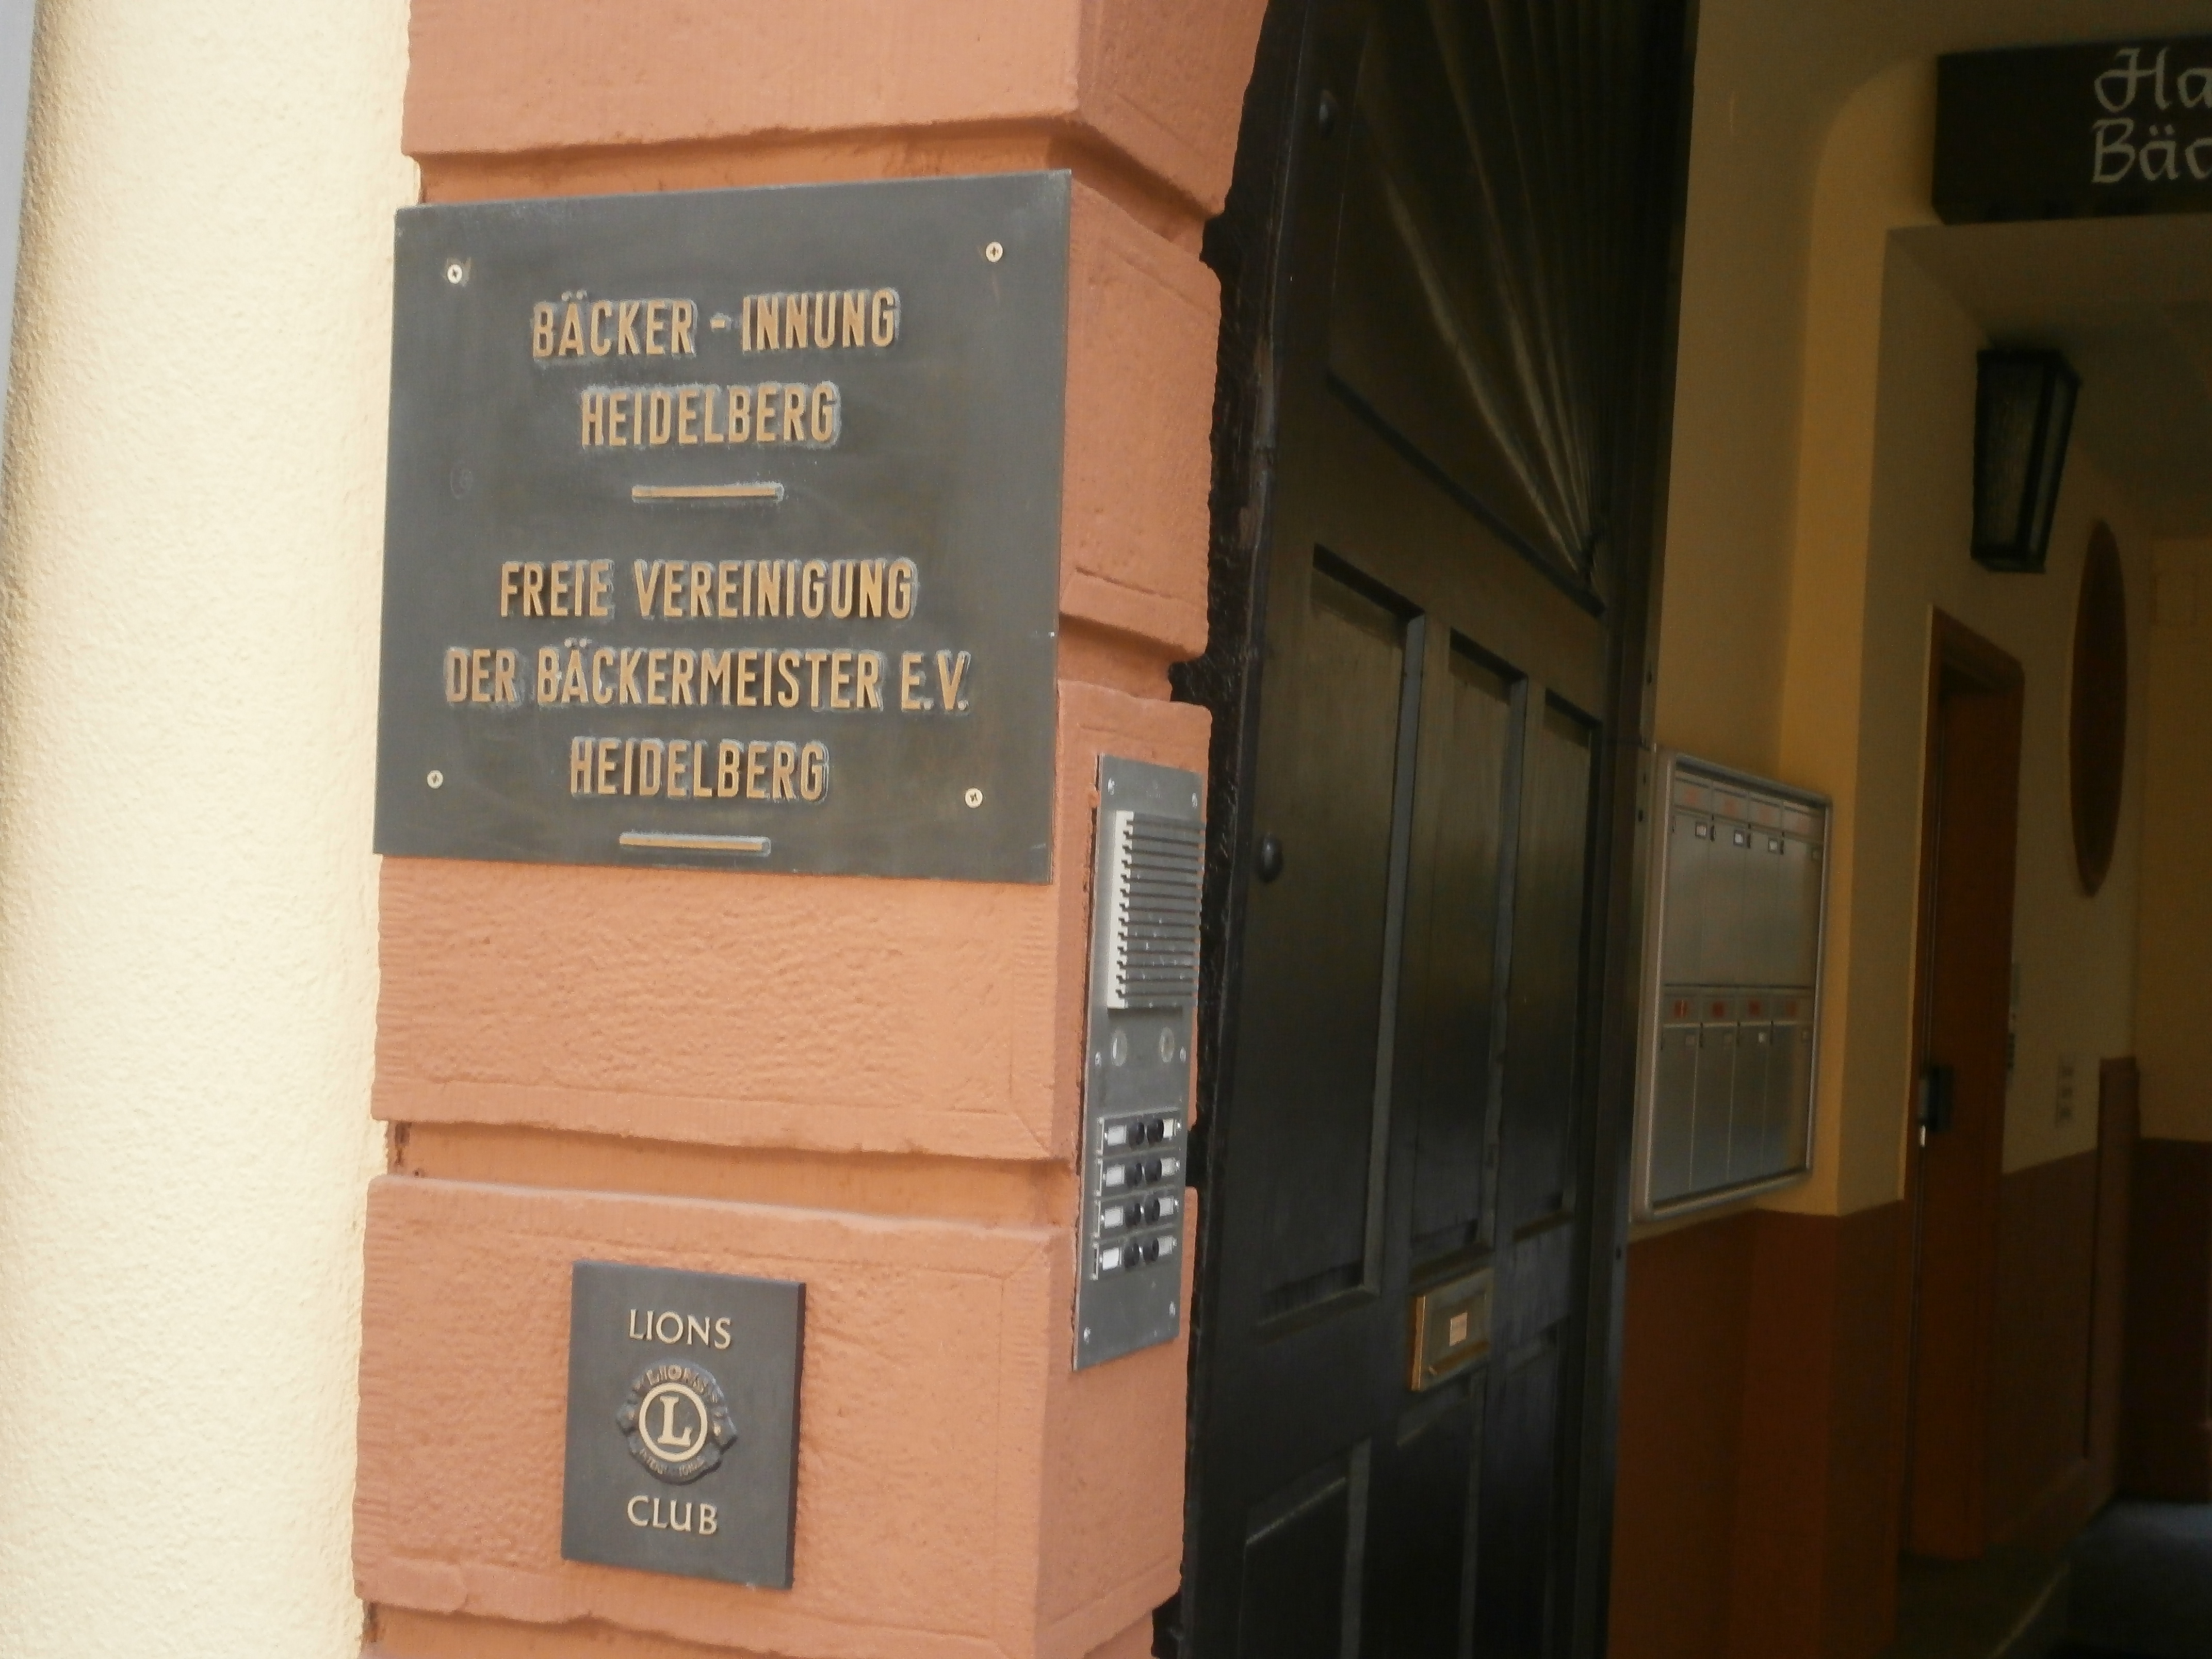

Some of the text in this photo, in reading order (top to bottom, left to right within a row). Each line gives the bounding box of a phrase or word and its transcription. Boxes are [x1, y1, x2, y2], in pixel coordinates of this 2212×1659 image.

[532, 290, 696, 359] BÄCKER
[742, 289, 899, 351] INNUNG
[581, 384, 839, 447] HEIDELBERG
[500, 558, 916, 620] FREIE VEREINIGUNG
[446, 639, 969, 711] DER BÄCKERMEISTER E.V.
[571, 739, 828, 802] HEIDELBERG
[629, 1309, 731, 1349] LIONS
[657, 1395, 693, 1447] L
[626, 1495, 718, 1535] CLUB
